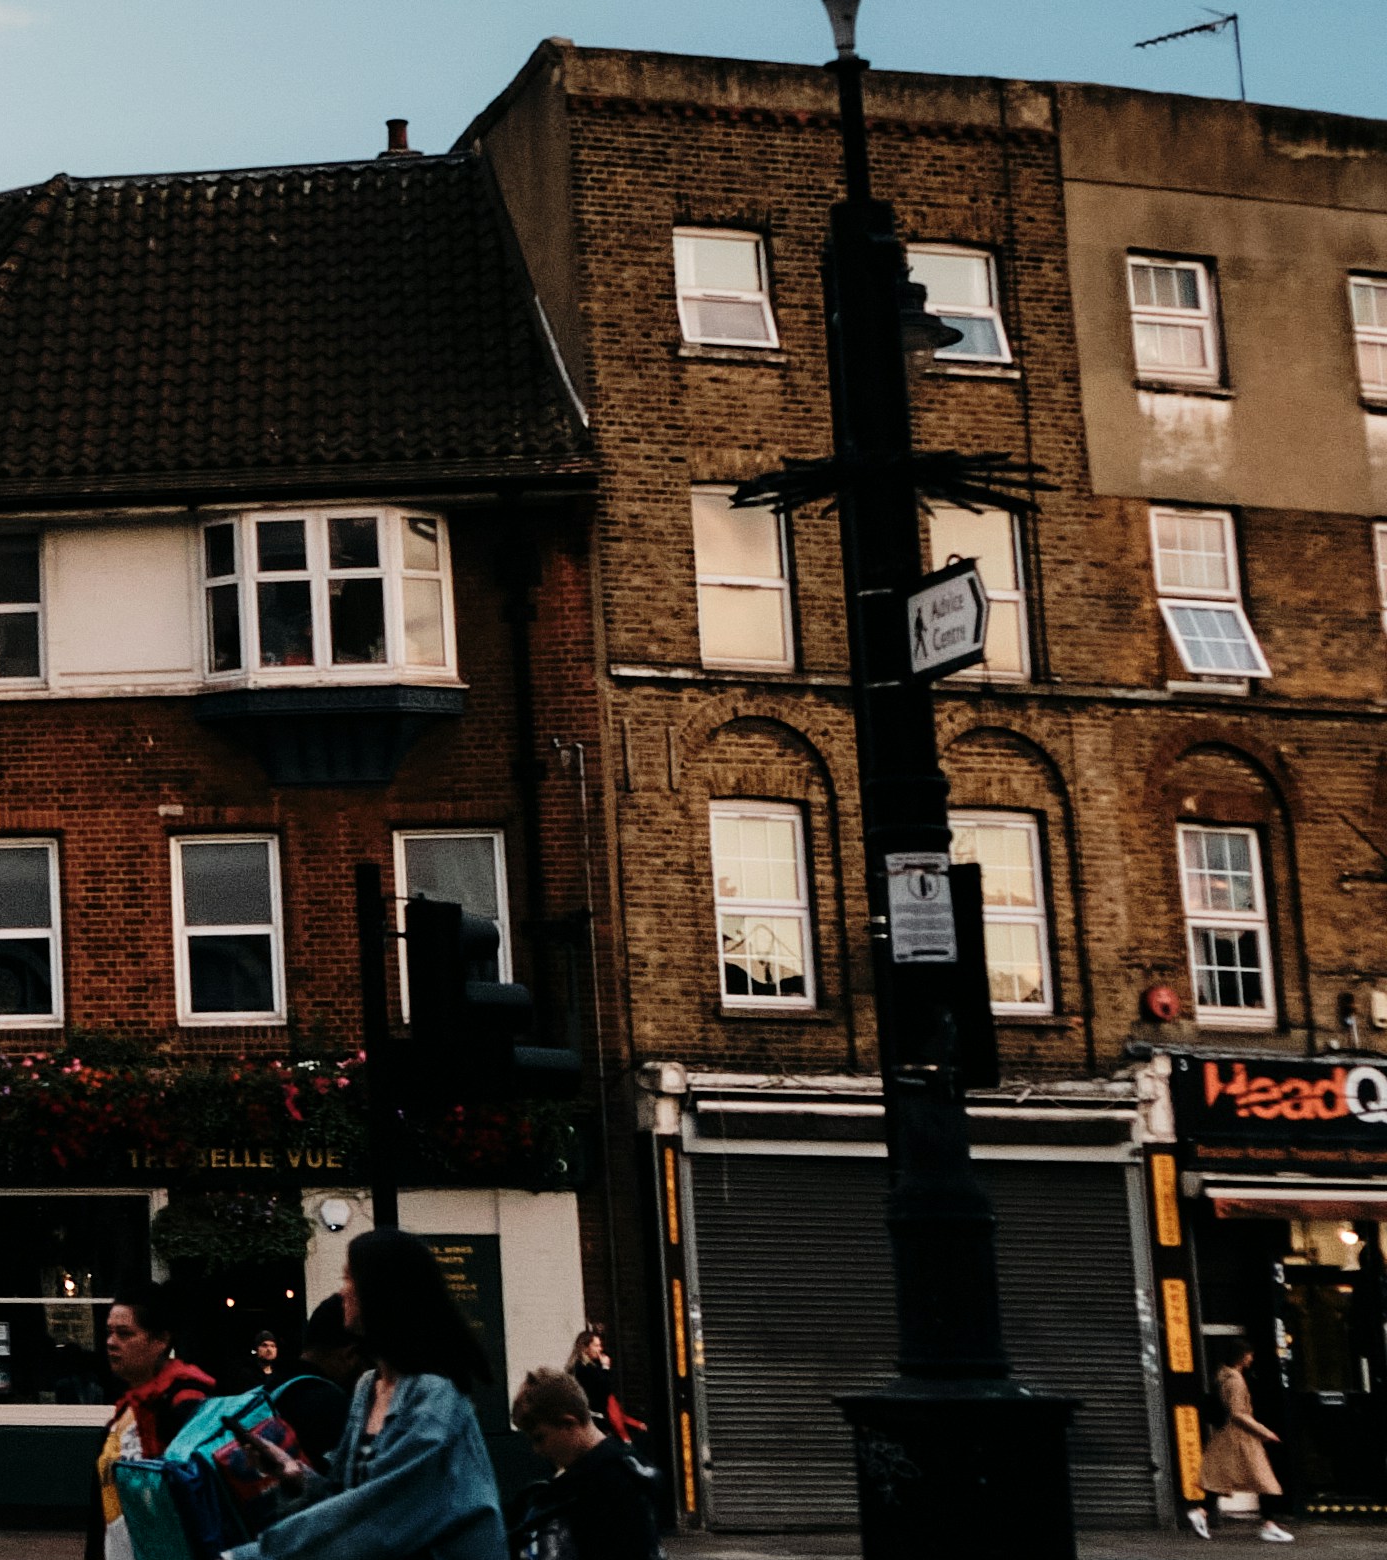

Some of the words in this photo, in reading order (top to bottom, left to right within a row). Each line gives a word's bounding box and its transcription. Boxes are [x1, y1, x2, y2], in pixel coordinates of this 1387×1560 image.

[932, 593, 964, 619] Advice
[1179, 1058, 1189, 1071] 3
[286, 1147, 344, 1169] VUE
